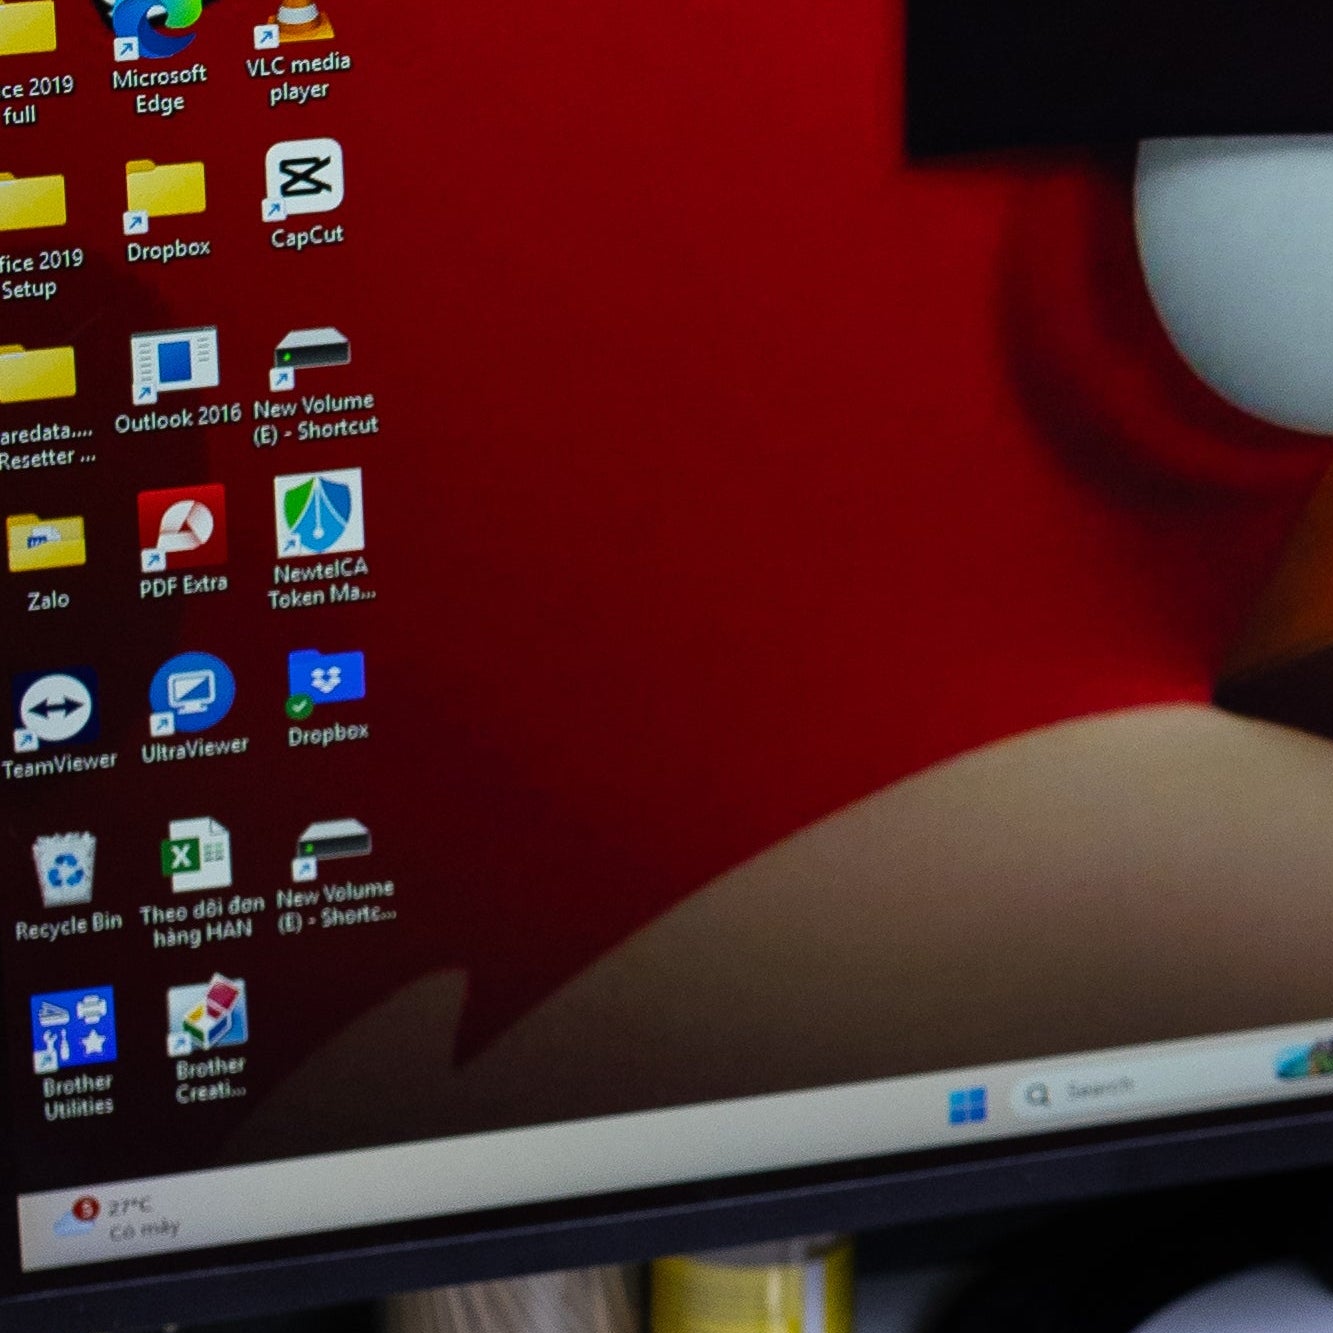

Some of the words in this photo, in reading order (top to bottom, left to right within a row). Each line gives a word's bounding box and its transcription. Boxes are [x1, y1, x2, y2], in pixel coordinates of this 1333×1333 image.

[246, 56, 285, 77] VLC
[291, 51, 351, 73] media
[29, 75, 74, 96] 2019
[112, 64, 208, 89] Microsoft
[136, 94, 185, 116] Edge
[270, 82, 330, 106] player
[3, 104, 36, 125] full
[271, 225, 344, 250] CapCut
[39, 248, 84, 269] 2019
[127, 239, 210, 263] Dropbox
[2, 278, 57, 300] Setup
[115, 408, 194, 433] Outlook
[198, 402, 242, 425] 2016
[253, 400, 297, 419] New
[302, 393, 375, 415] Volume
[253, 424, 278, 448] (E)
[298, 416, 379, 440] Shortcut
[0, 450, 75, 470] Resetter
[140, 576, 178, 598] PDF
[183, 574, 228, 595] Extra
[27, 590, 70, 611] Zalo
[267, 588, 325, 610] Token
[288, 722, 369, 748] Dropbox
[141, 736, 250, 764] UltraViewer
[2, 751, 118, 780] TeamViewer
[276, 888, 320, 909] New
[323, 880, 395, 903] Volume
[15, 915, 88, 942] Recycle
[91, 911, 123, 932] Bin
[139, 905, 188, 926] Theo
[206, 919, 253, 942] HAN
[176, 1056, 246, 1081] Brother
[42, 1073, 113, 1098] Brother
